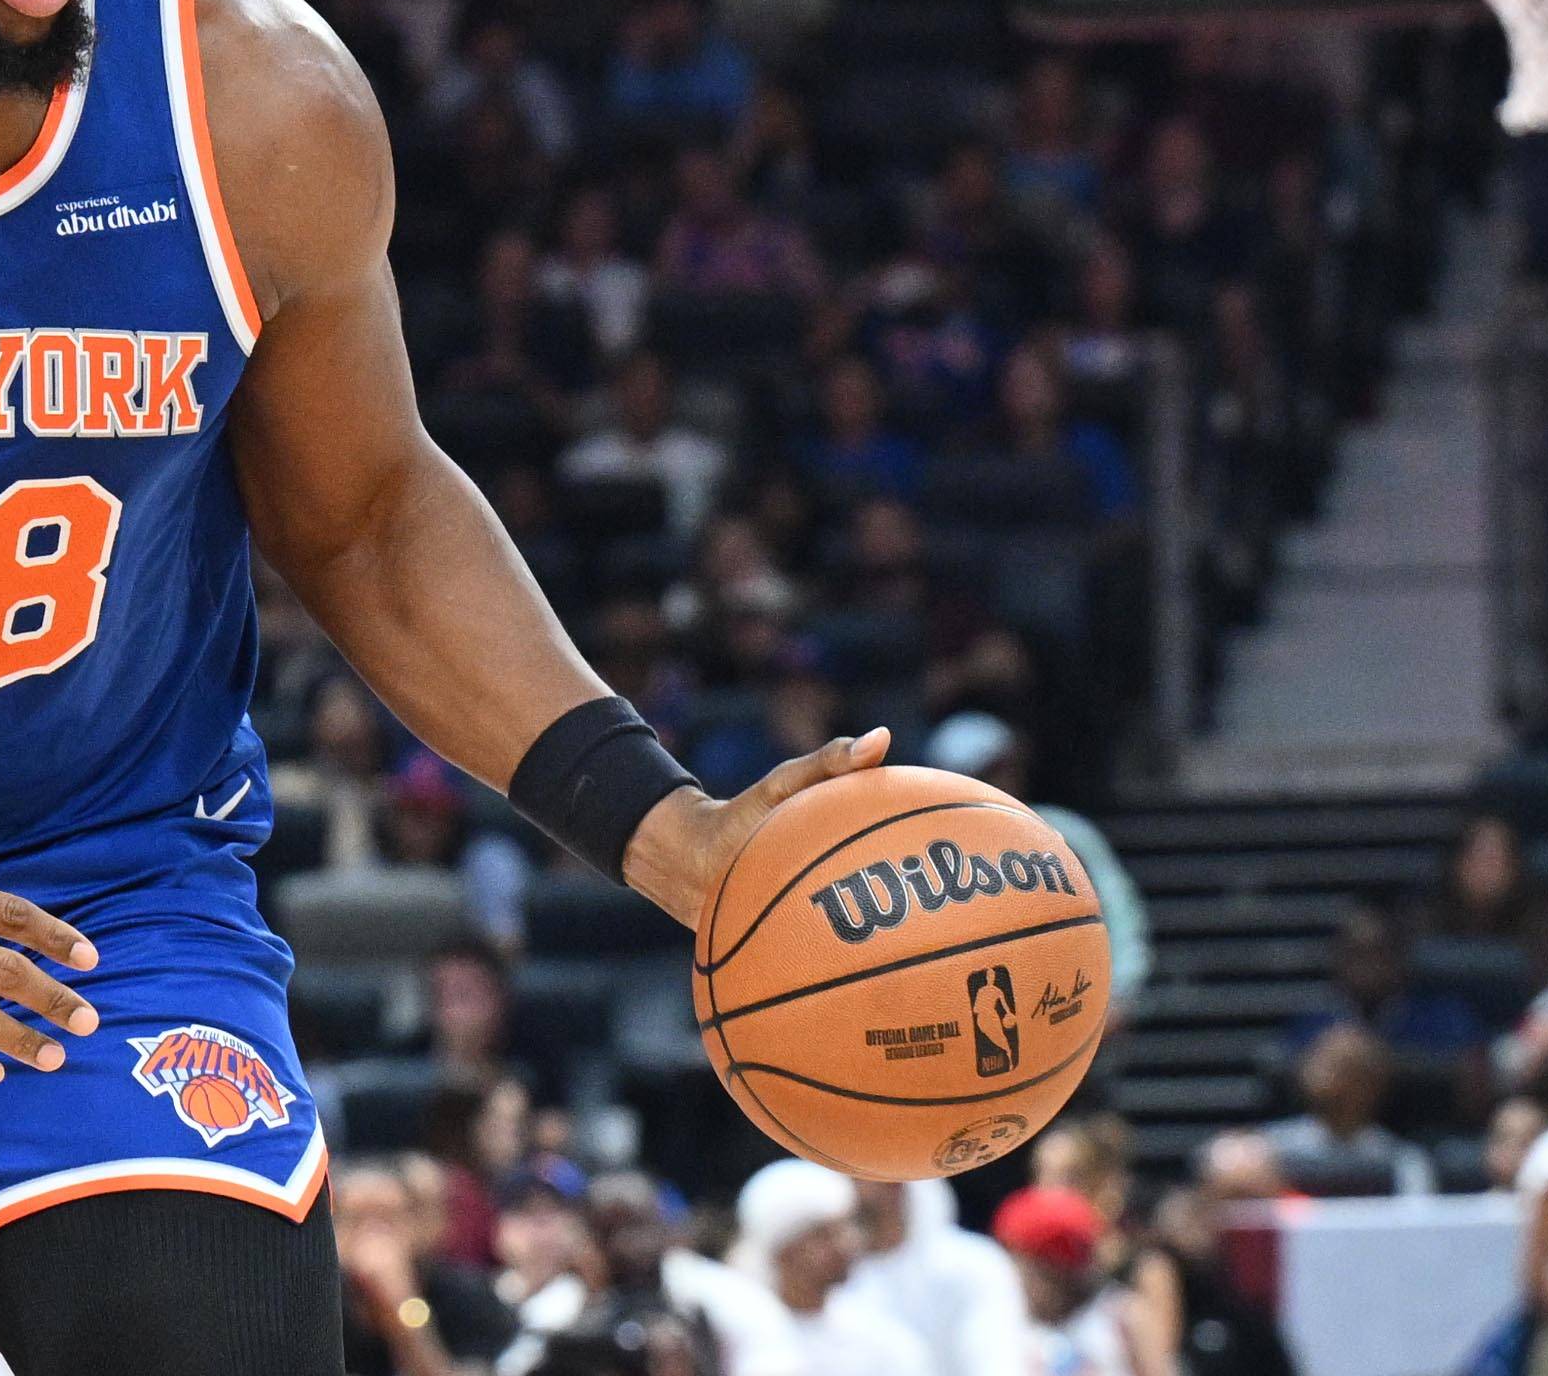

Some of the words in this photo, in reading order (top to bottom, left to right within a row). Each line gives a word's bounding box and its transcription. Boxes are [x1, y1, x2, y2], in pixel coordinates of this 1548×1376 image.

[55, 195, 120, 213] experience
[56, 212, 104, 236] abu
[810, 840, 1076, 944] Wilson
[193, 1029, 220, 1041] NEW
[866, 1027, 907, 1046] OFFICIAL
[909, 1024, 936, 1043] GAME
[937, 1021, 961, 1039] BALL
[141, 1032, 286, 1120] KNICKS
